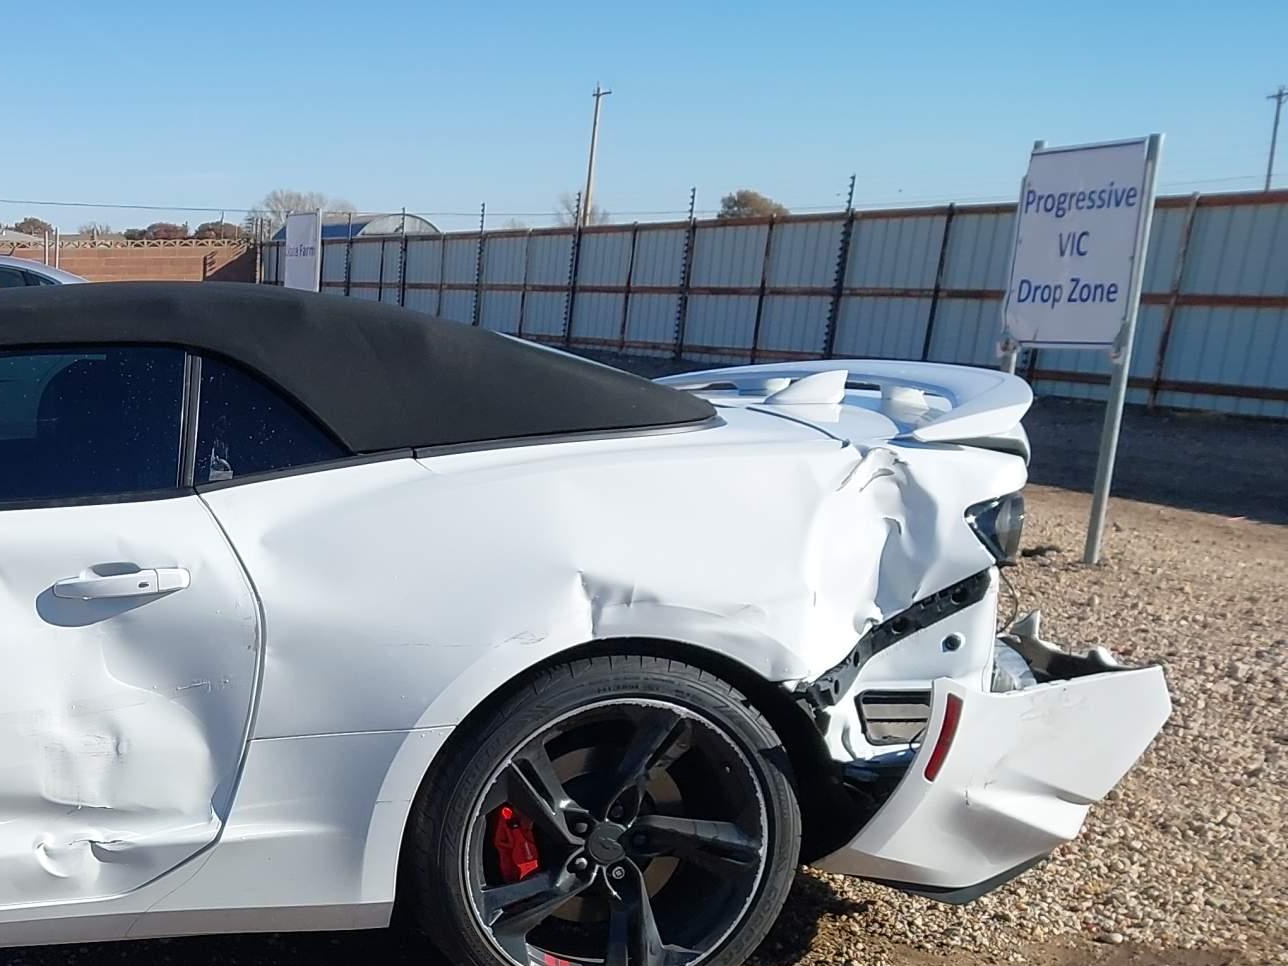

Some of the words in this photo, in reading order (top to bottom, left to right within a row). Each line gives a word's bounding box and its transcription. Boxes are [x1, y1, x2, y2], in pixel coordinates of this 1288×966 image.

[1025, 182, 1137, 218] Progressive
[1058, 230, 1090, 257] VIC
[1016, 279, 1064, 309] Drop
[1067, 278, 1118, 303] Zone
